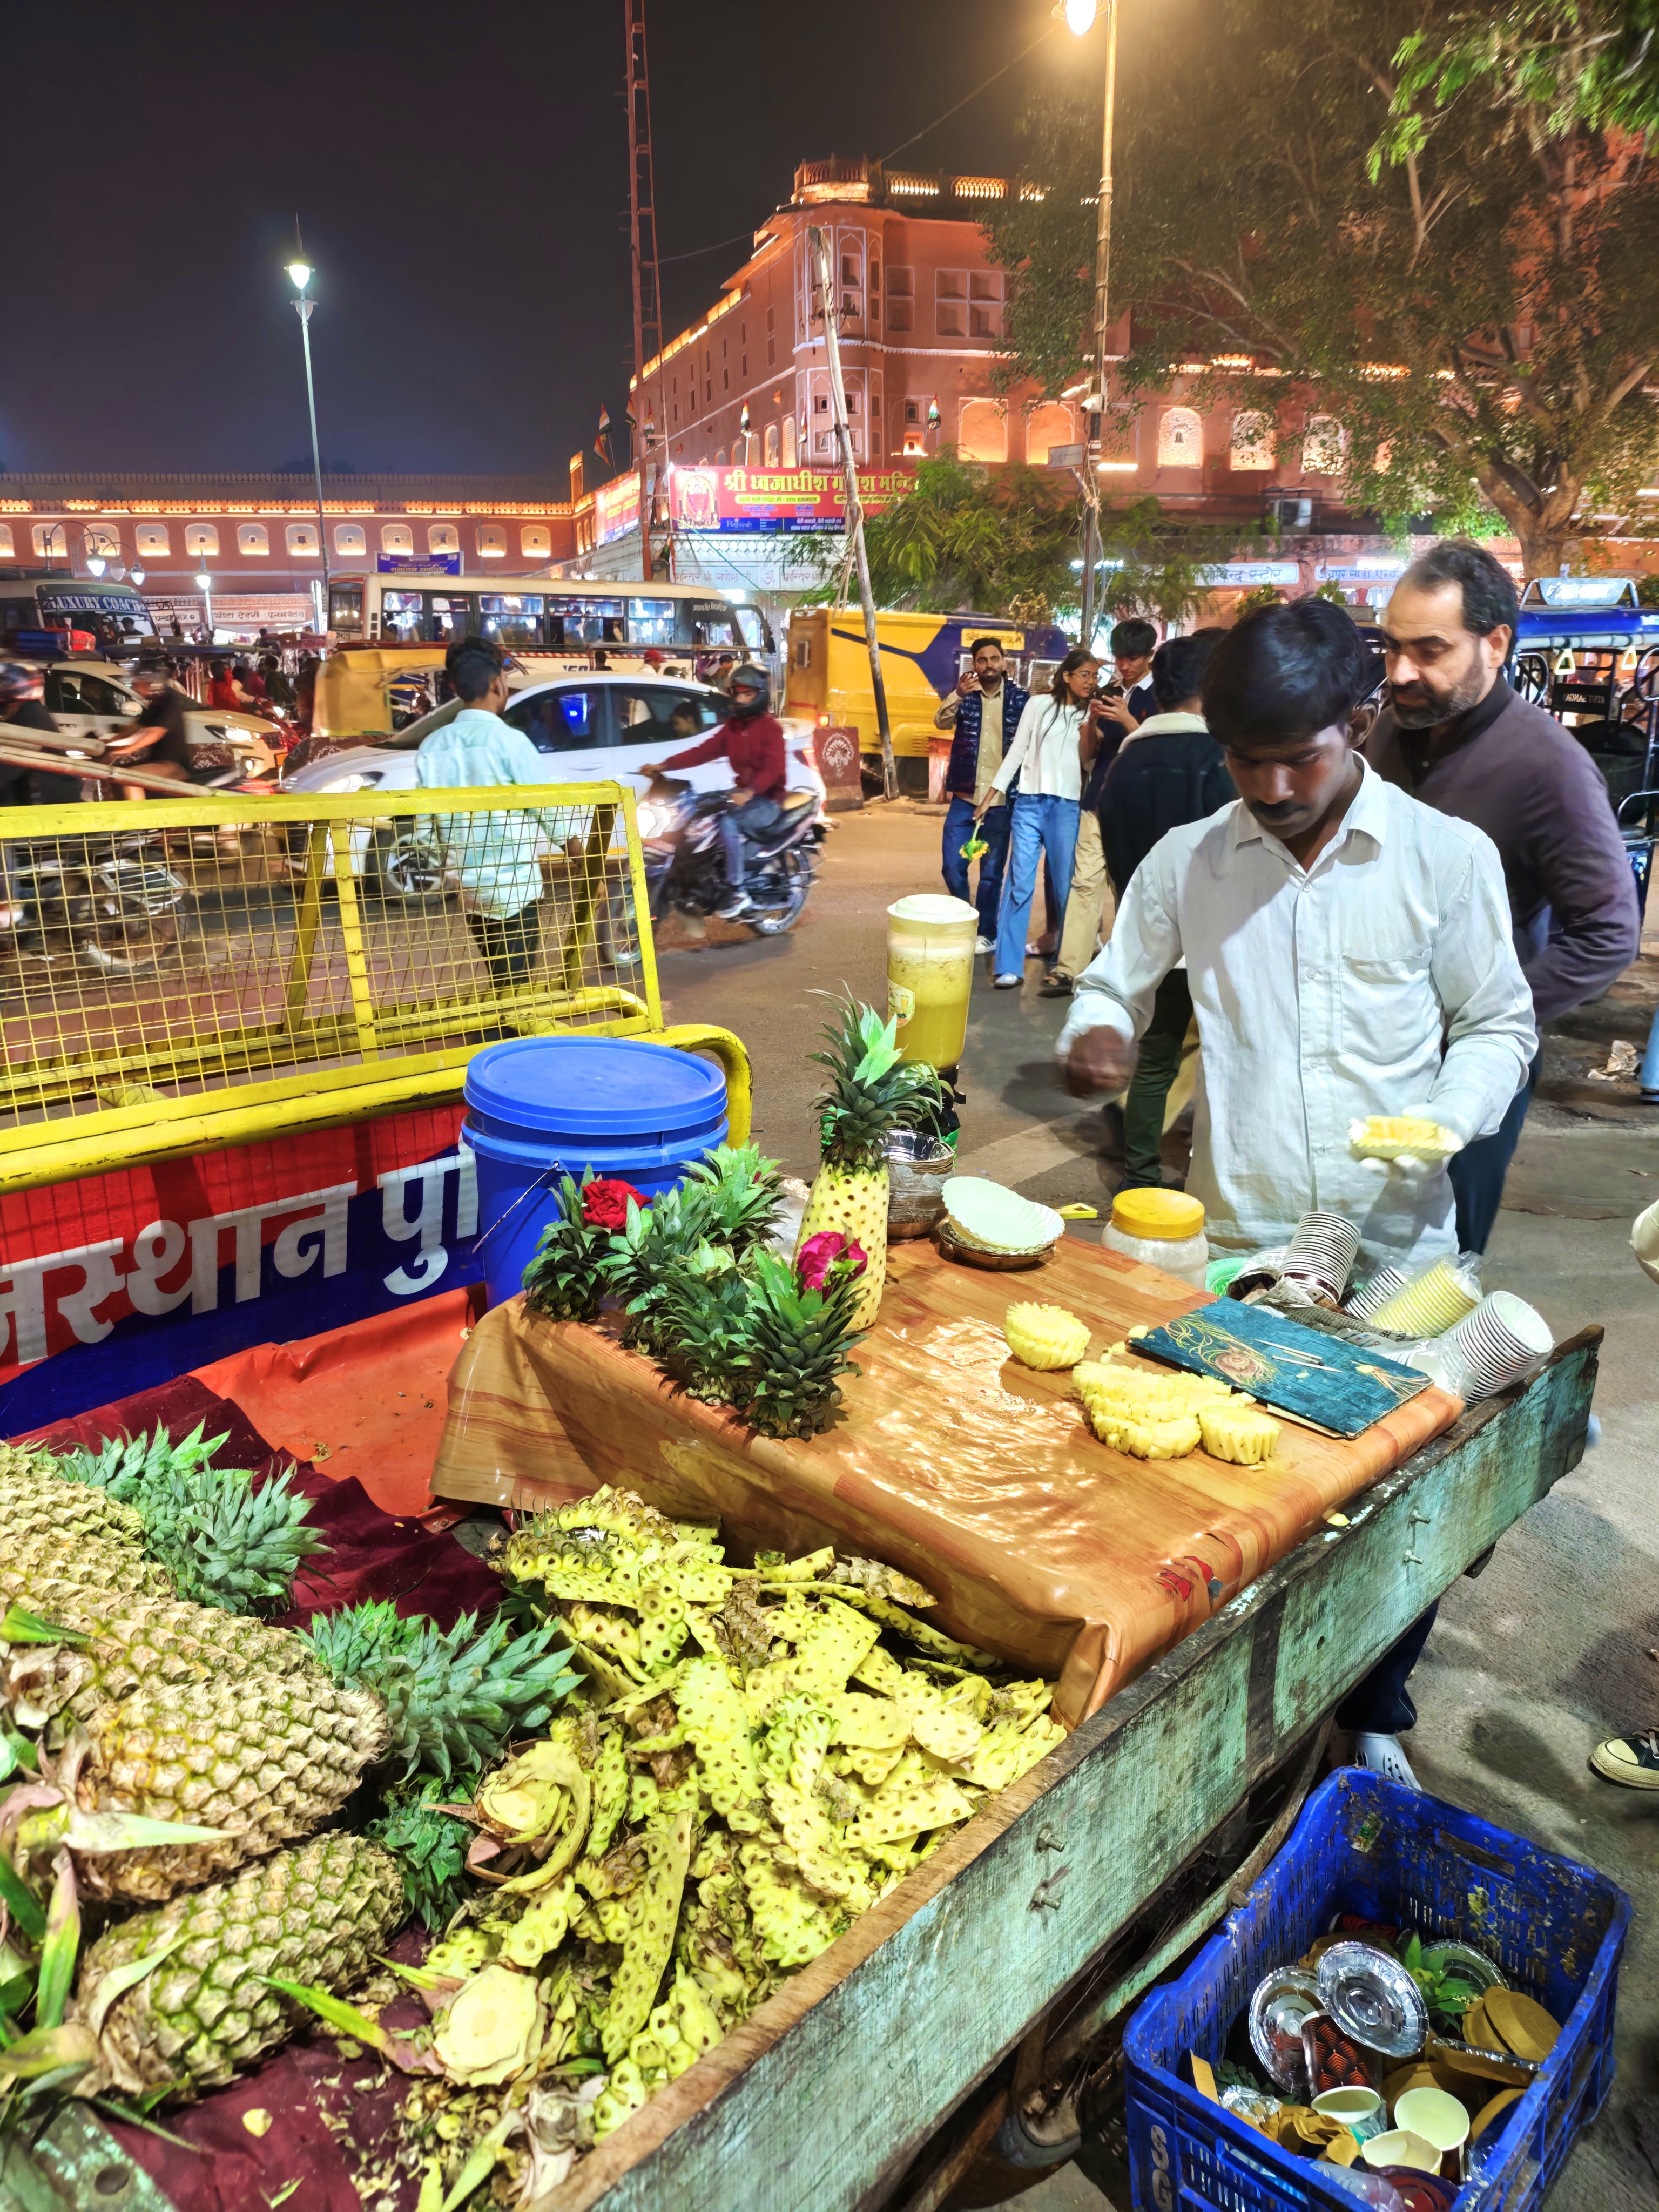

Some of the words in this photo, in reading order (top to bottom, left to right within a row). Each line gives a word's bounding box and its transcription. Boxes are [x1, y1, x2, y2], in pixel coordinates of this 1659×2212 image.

[724, 469, 747, 492] श्री
[750, 469, 828, 493] ध्वजाधीश
[676, 570, 700, 583] मन्दिर
[716, 570, 738, 582] गणेश
[1250, 567, 1283, 581] स्टोर
